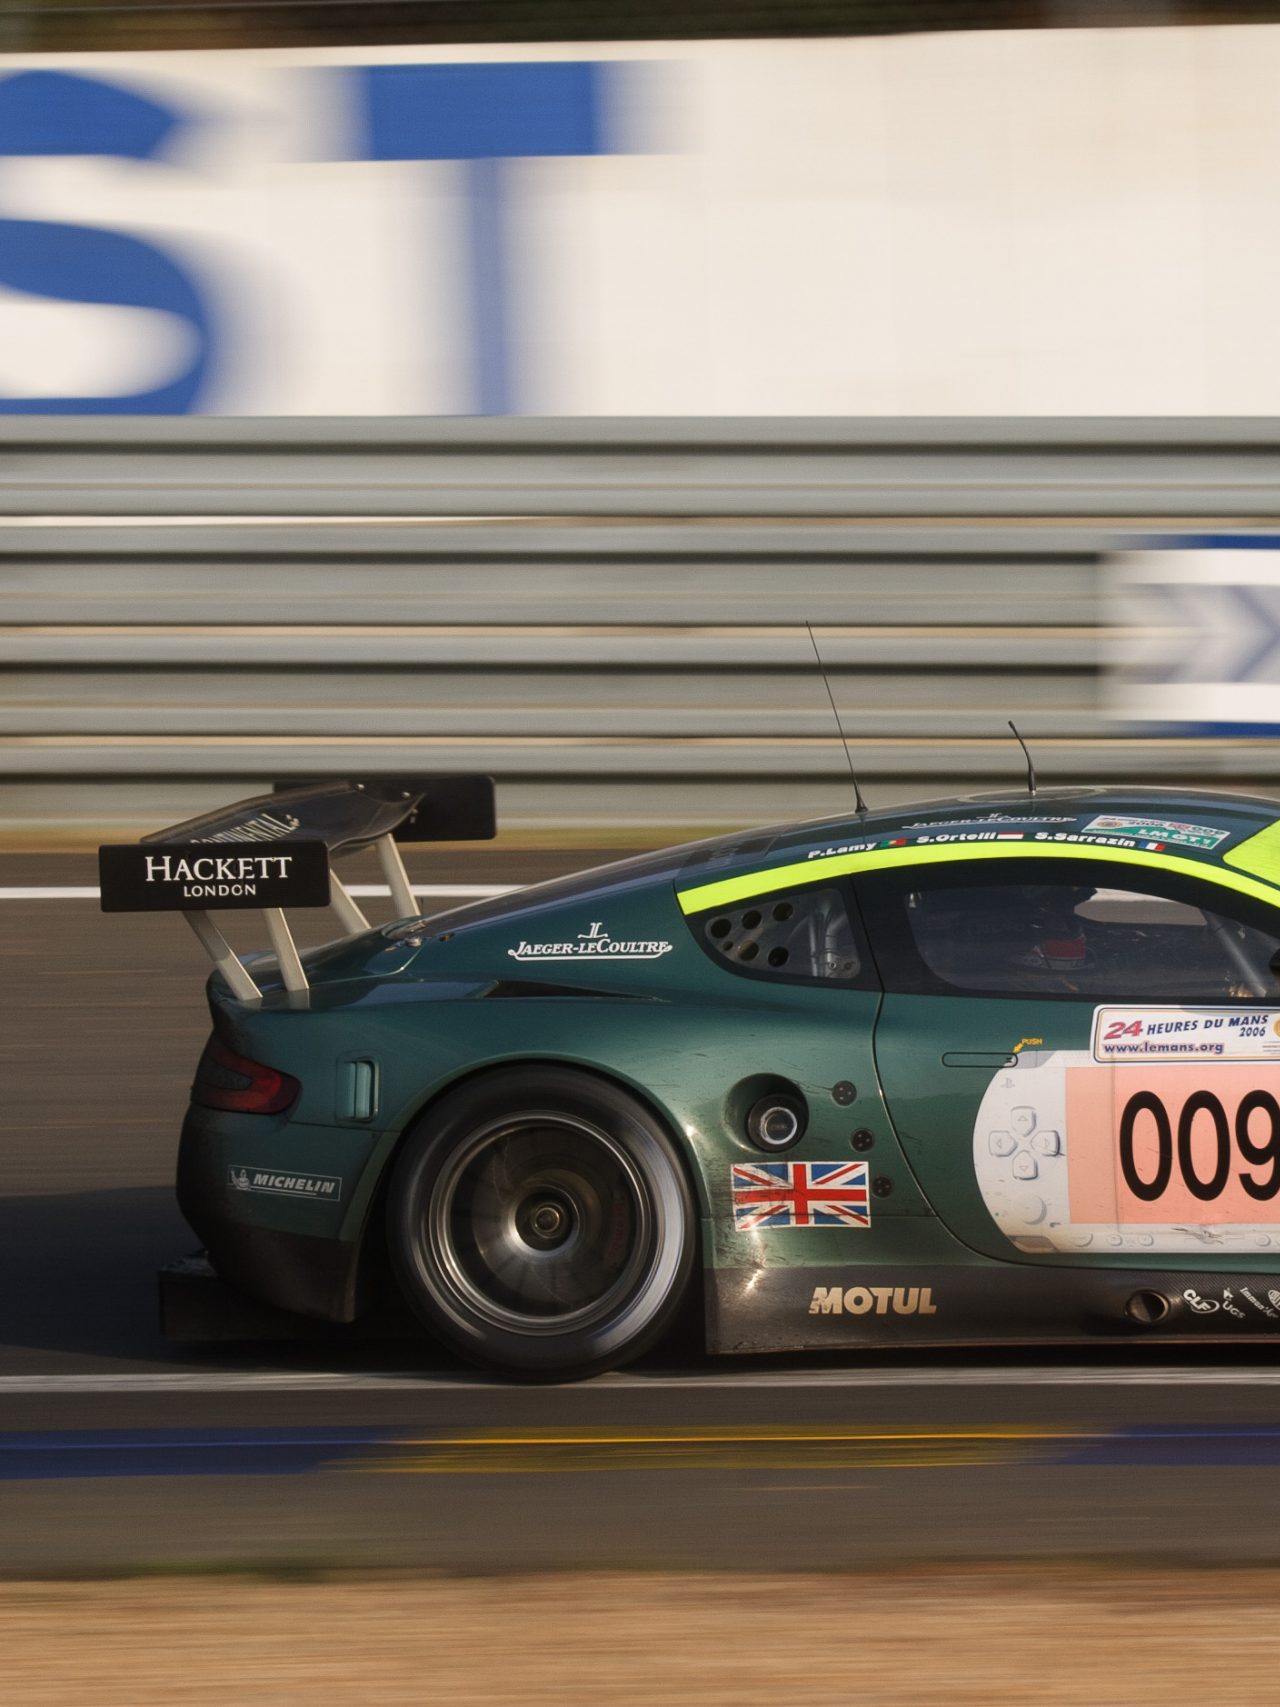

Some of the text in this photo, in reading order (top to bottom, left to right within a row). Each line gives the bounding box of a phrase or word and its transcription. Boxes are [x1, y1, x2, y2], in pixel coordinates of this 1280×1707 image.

[916, 831, 998, 844] S.Ortelli
[1034, 831, 1136, 848] S.Sarrazin
[808, 842, 877, 858] P.Lamy
[145, 855, 292, 882] HACKETT
[184, 884, 257, 898] LONDON
[1103, 1014, 1269, 1041] 24 HEURES DU MANS
[1238, 1026, 1266, 1038] 2006
[1103, 1041, 1225, 1055] www.lemans.org
[253, 1173, 336, 1194] MICHELIN
[807, 1286, 938, 1315] MOTUL
